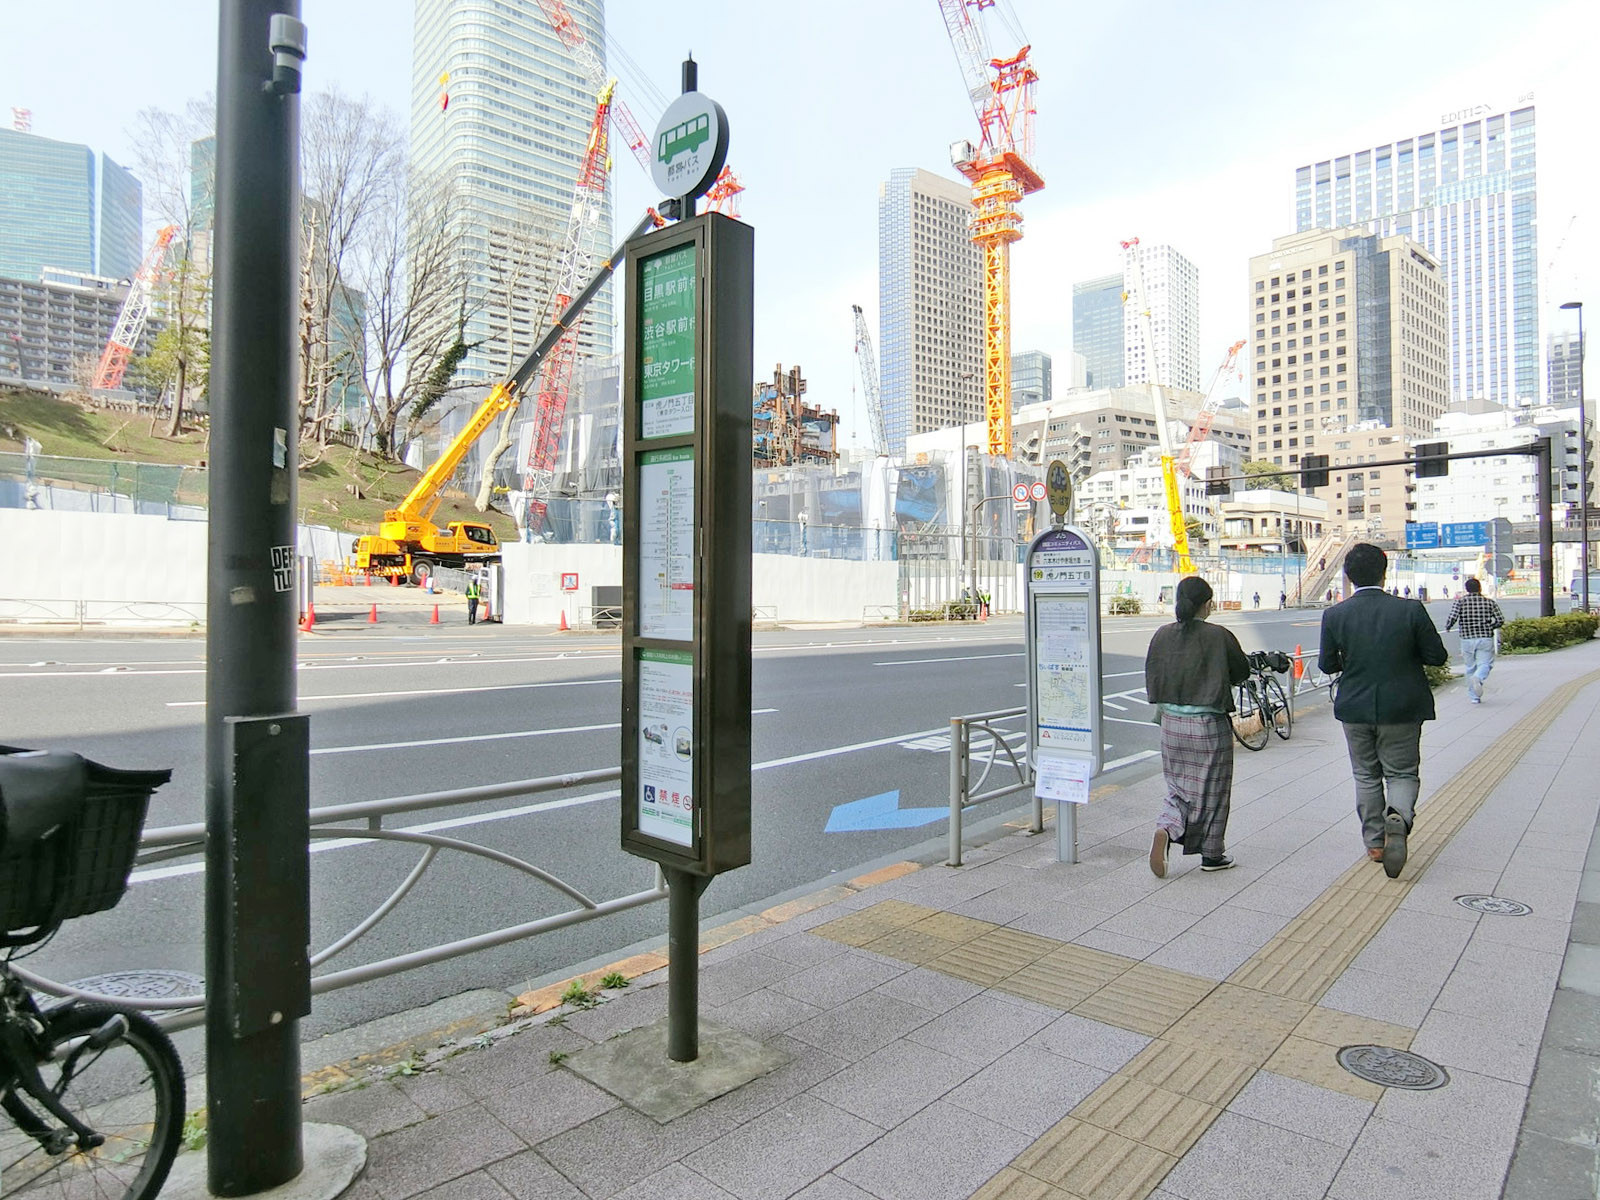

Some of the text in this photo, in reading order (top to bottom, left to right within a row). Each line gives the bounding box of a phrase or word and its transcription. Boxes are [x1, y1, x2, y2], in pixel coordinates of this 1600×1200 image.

[1441, 104, 1492, 125] EDITION
[1034, 487, 1043, 496] 50
[1047, 570, 1091, 580] 虎ノ門五丁目
